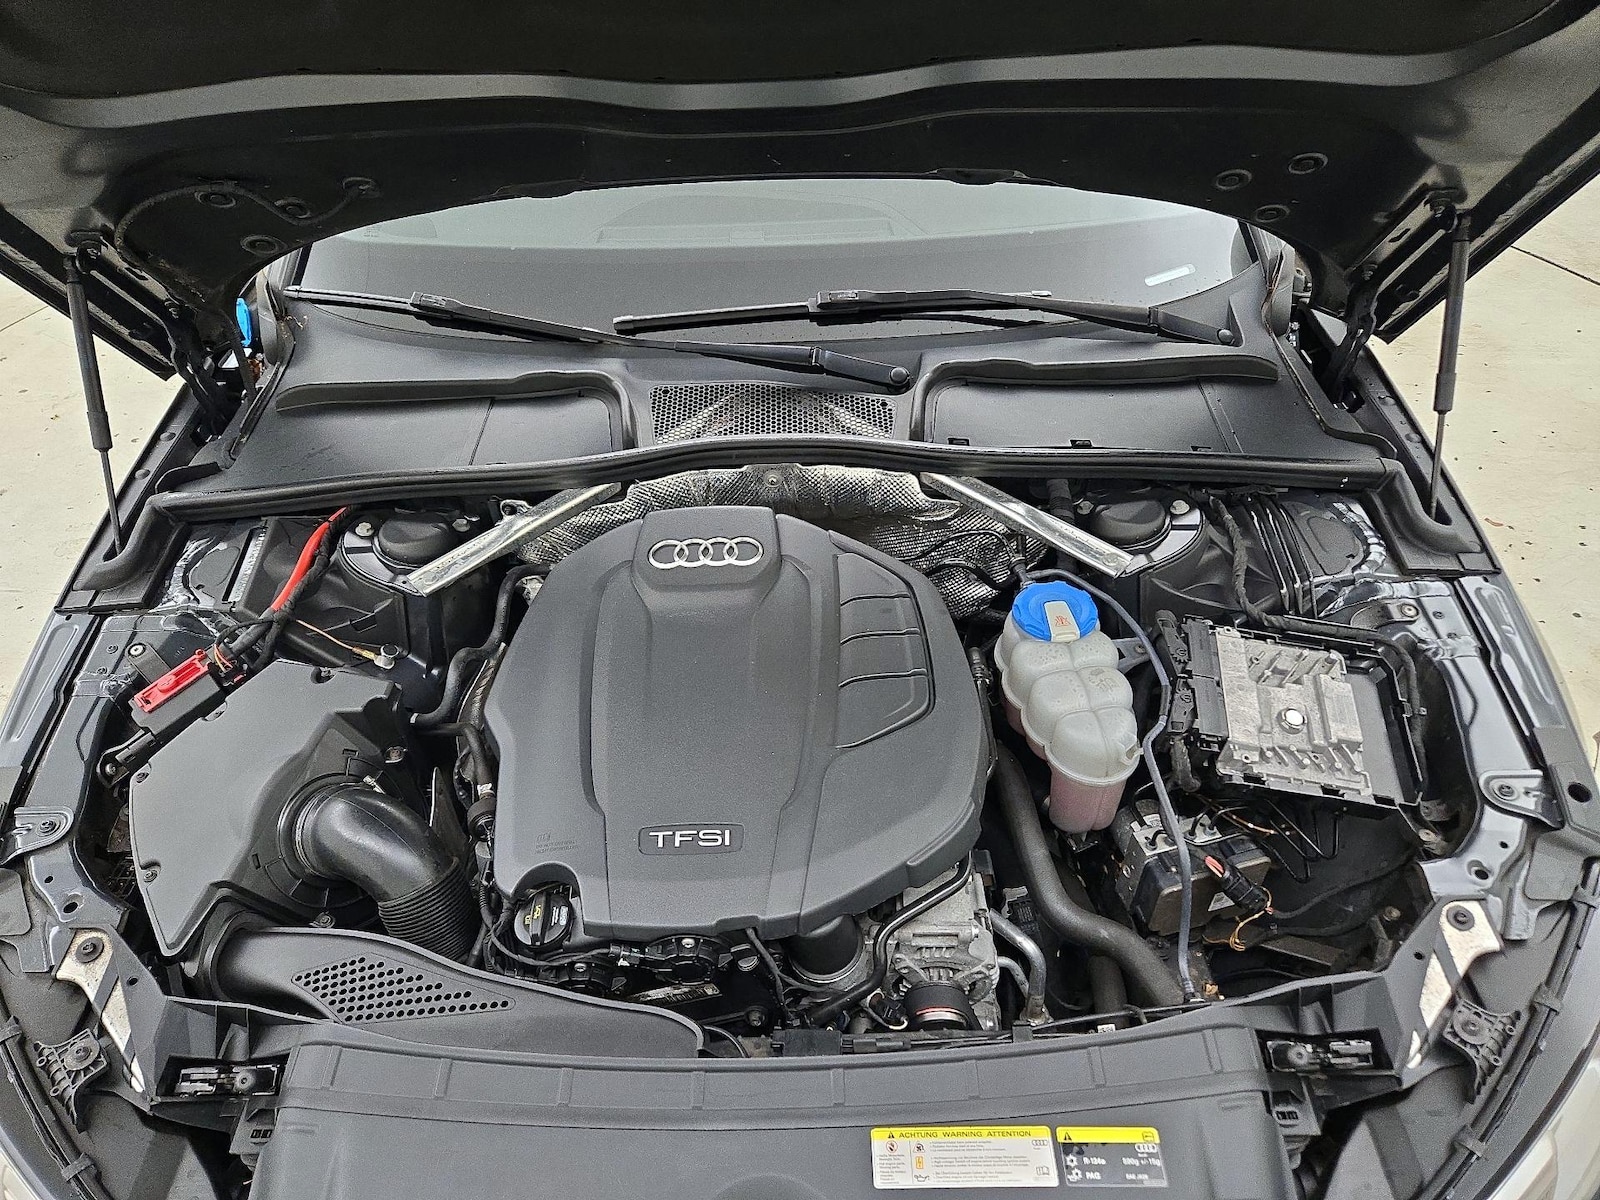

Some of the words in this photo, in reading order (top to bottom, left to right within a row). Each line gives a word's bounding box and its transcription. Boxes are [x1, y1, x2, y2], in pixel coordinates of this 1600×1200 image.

[648, 829, 730, 848] TFSI
[898, 1131, 938, 1139] ACHTUNG
[942, 1130, 982, 1138] WARNING
[986, 1130, 1032, 1138] ATTENTION
